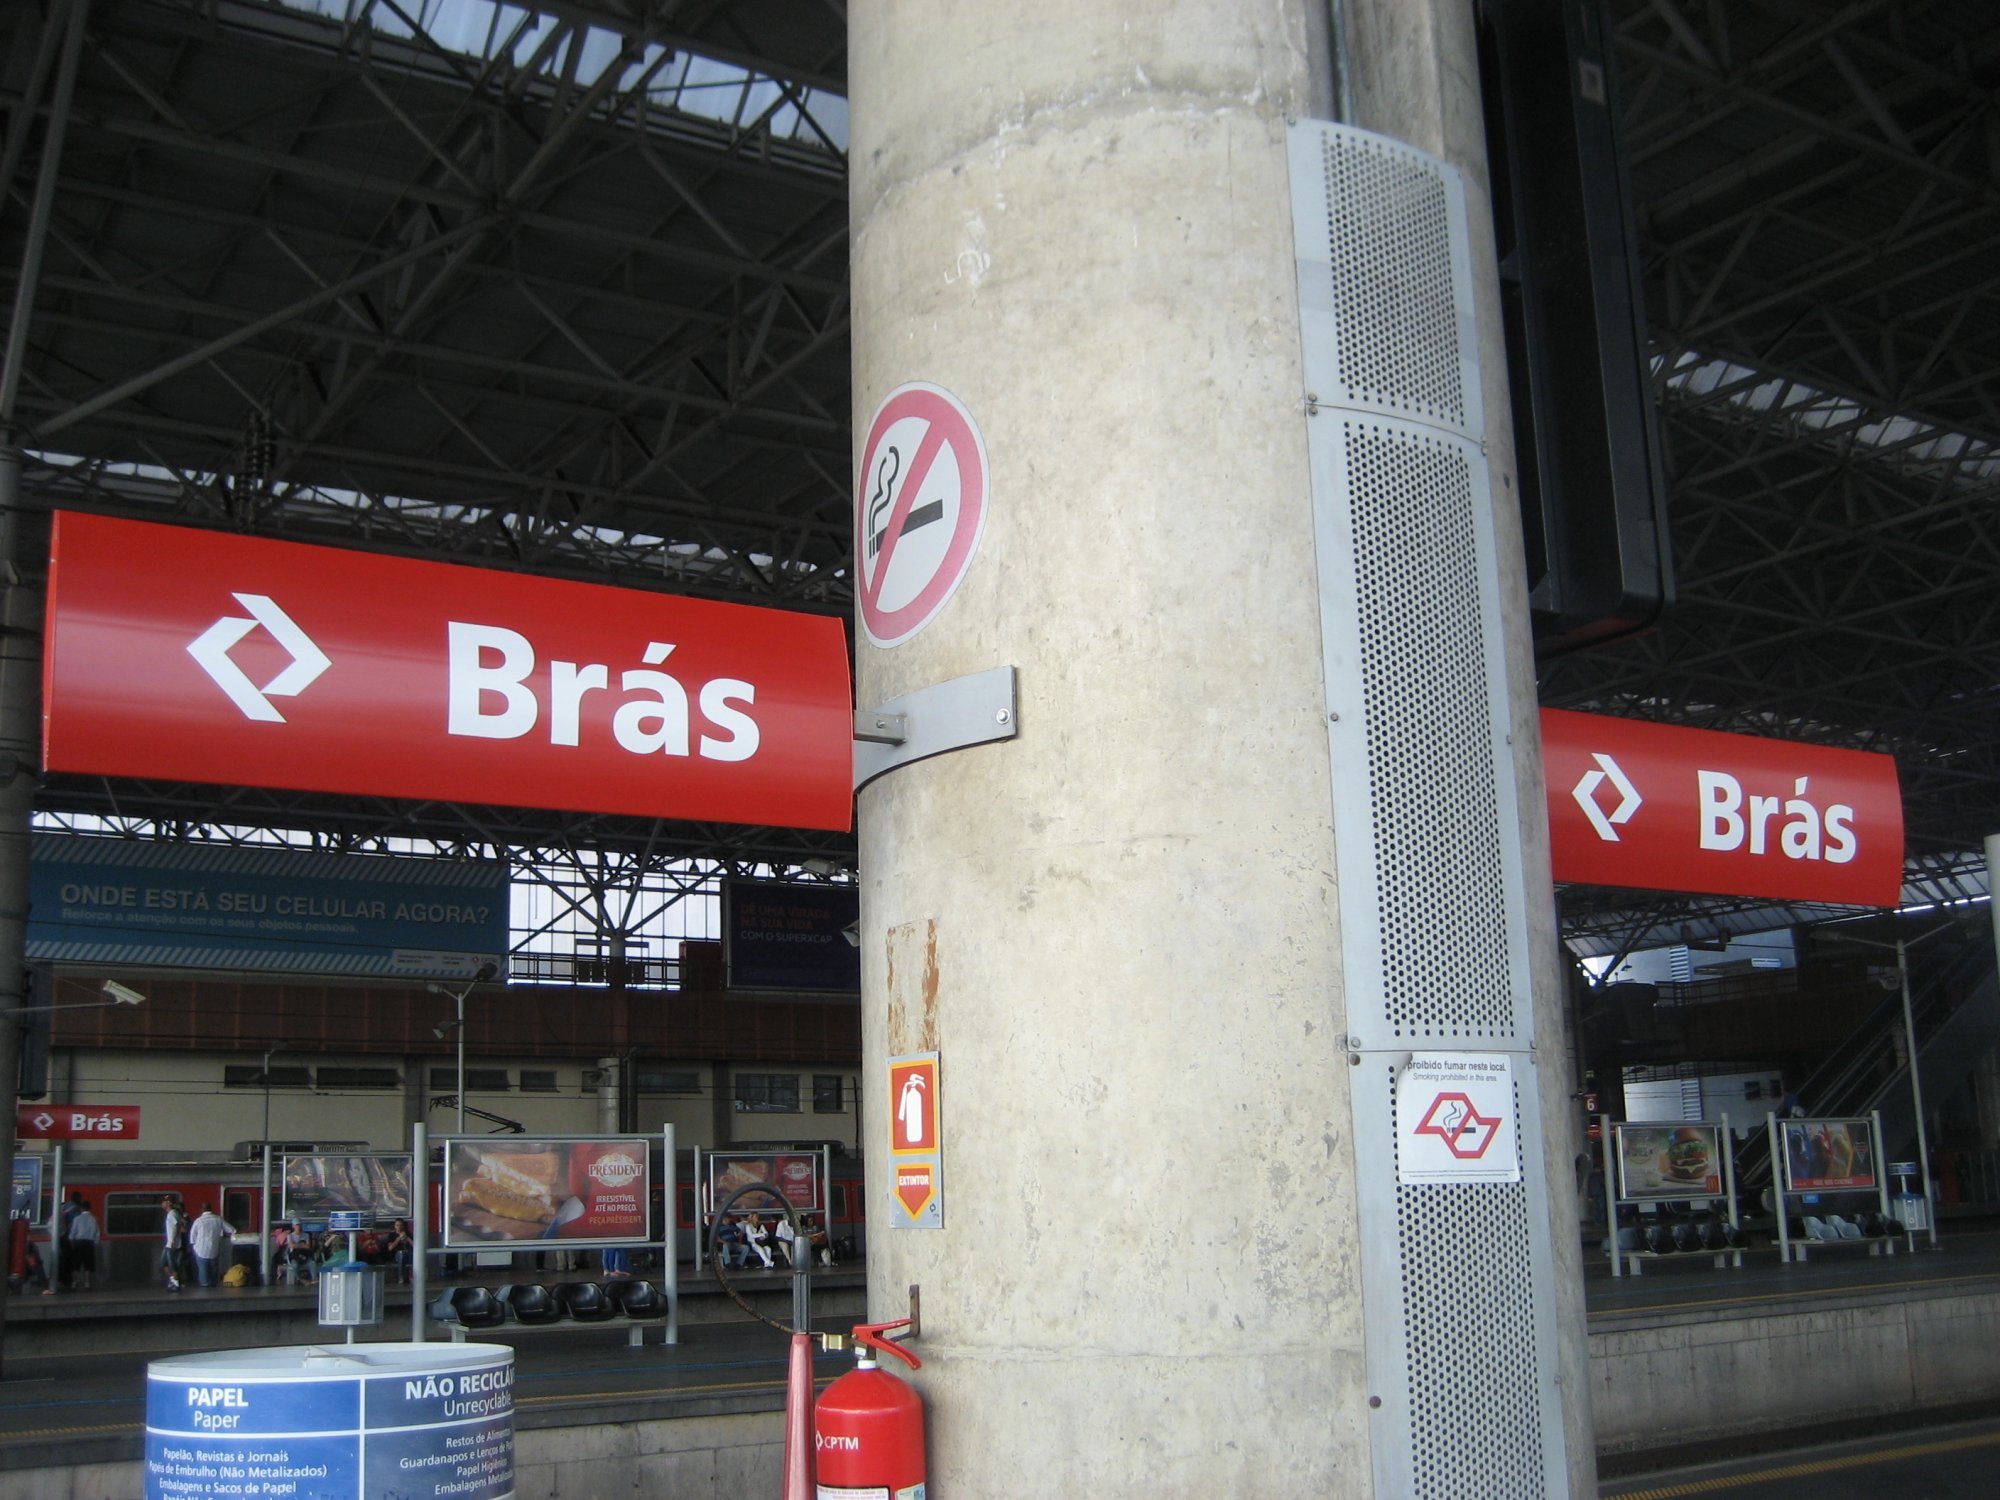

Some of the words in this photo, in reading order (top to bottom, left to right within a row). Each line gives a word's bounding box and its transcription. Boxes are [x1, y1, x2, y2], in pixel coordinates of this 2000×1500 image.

[448, 621, 761, 763] Brás
[1697, 769, 1857, 864] Brás
[60, 884, 137, 907] ONDE
[145, 886, 210, 911] ESTÁ
[218, 892, 267, 914] SEU
[275, 896, 387, 919] CELULAR
[394, 902, 489, 925] AGORA?
[62, 908, 113, 921] Reforce
[116, 912, 124, 921] a
[127, 912, 176, 926] atenção
[180, 915, 207, 926] com
[210, 917, 224, 927] os
[227, 918, 255, 928] seus
[258, 919, 303, 931] objetos
[740, 930, 764, 941] COM
[765, 931, 774, 941] O
[1407, 1060, 1442, 1072] proibido
[1444, 1060, 1467, 1071] fumar
[1469, 1061, 1488, 1071] neste
[1586, 1098, 1595, 1111] 6
[71, 1112, 123, 1131] Brás
[899, 1175, 929, 1187] EXTINTOR
[596, 1194, 636, 1203] IRRESISTÍVEL
[594, 1203, 606, 1212] ATÉ
[607, 1204, 616, 1212] NO
[405, 1376, 454, 1400] NÃO
[188, 1387, 249, 1407] PAPEL
[444, 1391, 511, 1417] Unrecyclable
[194, 1410, 240, 1432] Paper
[446, 1436, 474, 1449] Restos
[476, 1434, 485, 1444] de
[825, 1437, 859, 1450] CPTM
[196, 1450, 235, 1463] Revistas
[247, 1451, 289, 1463] Jornais
[400, 1452, 468, 1469] Guardanapos
[470, 1450, 475, 1458] e
[165, 1465, 174, 1475] de
[176, 1464, 217, 1477] Embrulho
[219, 1466, 245, 1479] (Não
[248, 1464, 328, 1478] Metalizados)
[457, 1464, 480, 1477] Papel
[159, 1478, 203, 1494] Embalagens
[205, 1484, 211, 1493] e
[213, 1482, 242, 1494] Sacos
[245, 1482, 259, 1493] de
[263, 1481, 296, 1495] Papel
[435, 1477, 487, 1495] Embalagens
